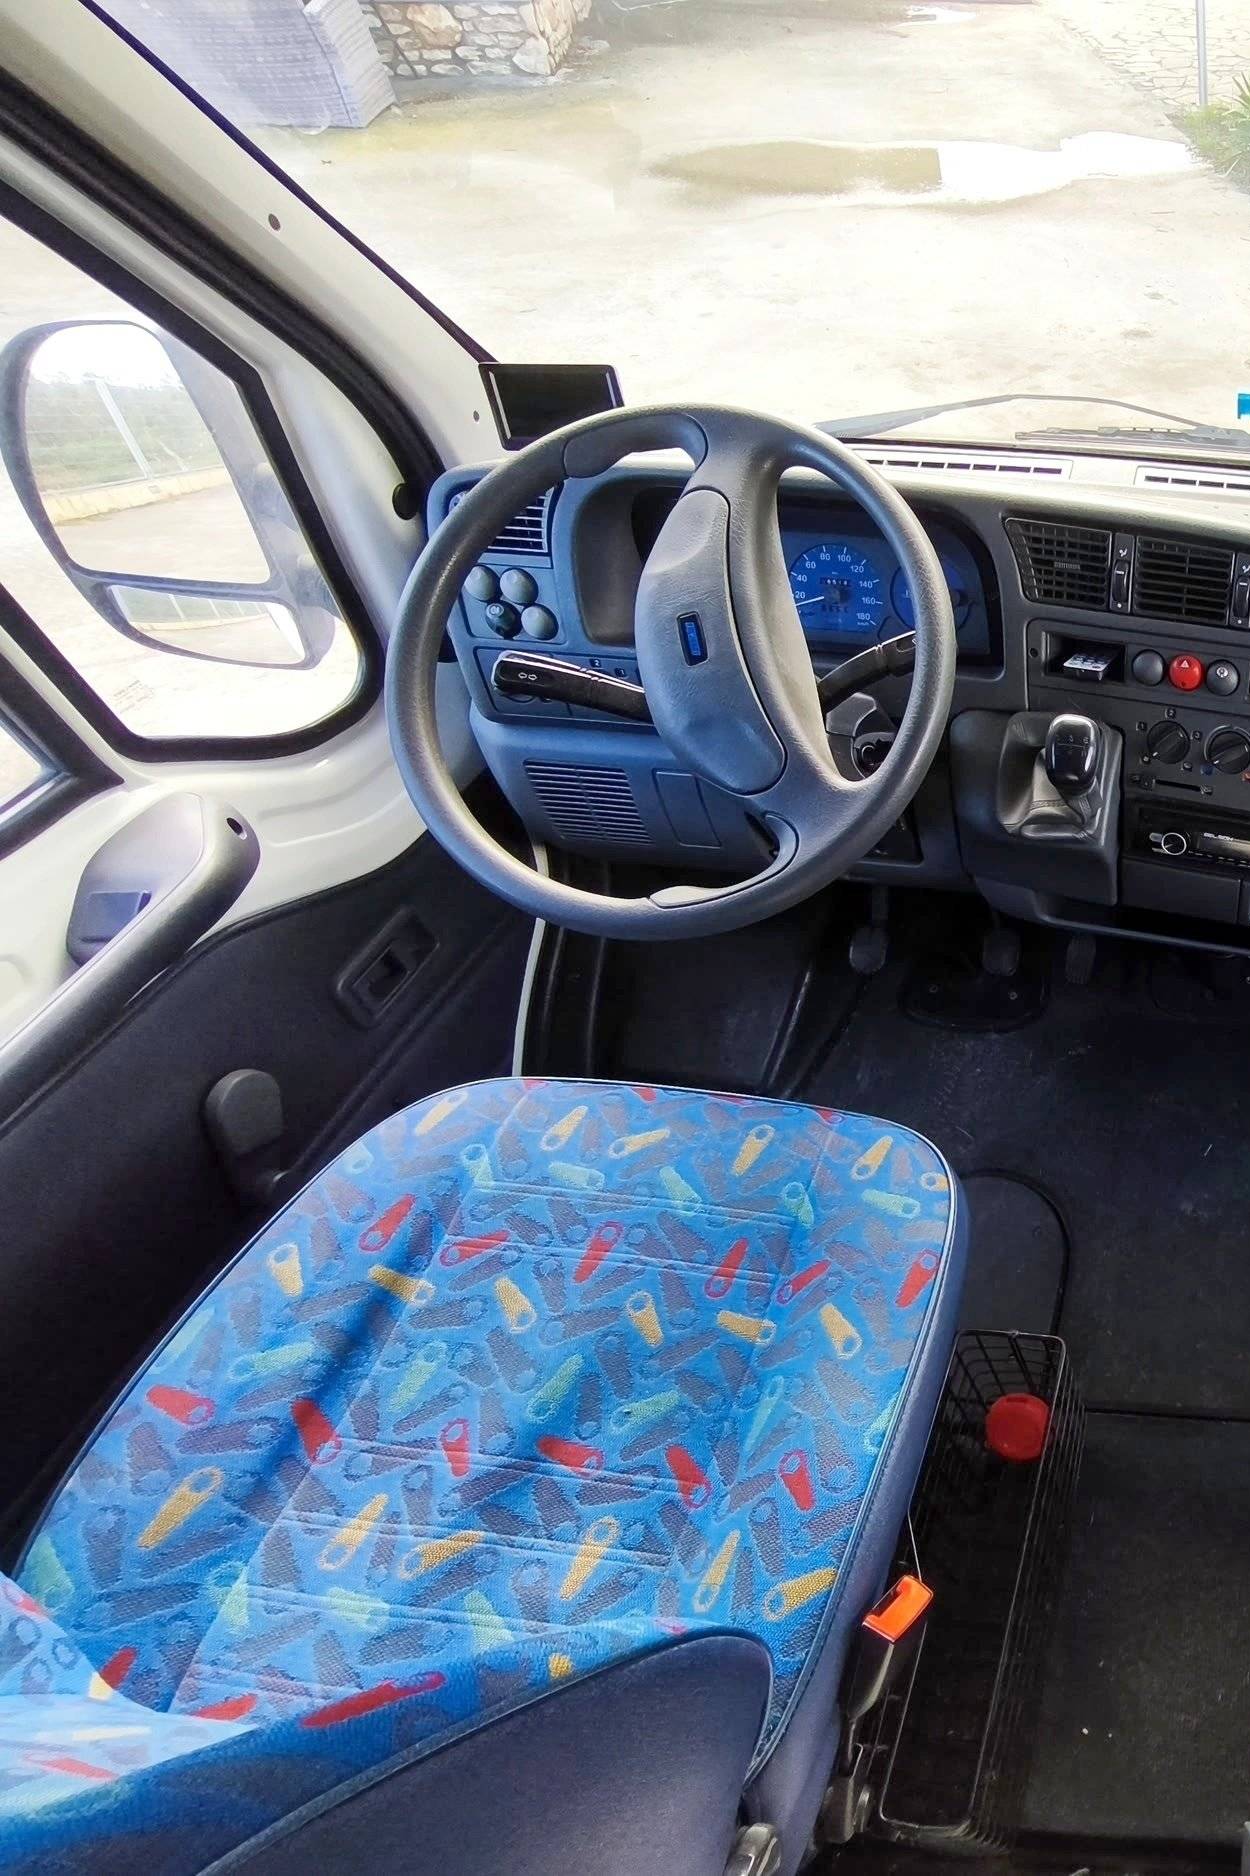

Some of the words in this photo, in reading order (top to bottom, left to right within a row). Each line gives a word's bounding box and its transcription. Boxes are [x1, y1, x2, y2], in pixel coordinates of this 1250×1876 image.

[837, 554, 851, 562] 100
[805, 561, 816, 569] 60
[850, 565, 864, 573] 120
[797, 574, 807, 582] 40
[859, 580, 873, 588] 140
[795, 591, 806, 599] 20
